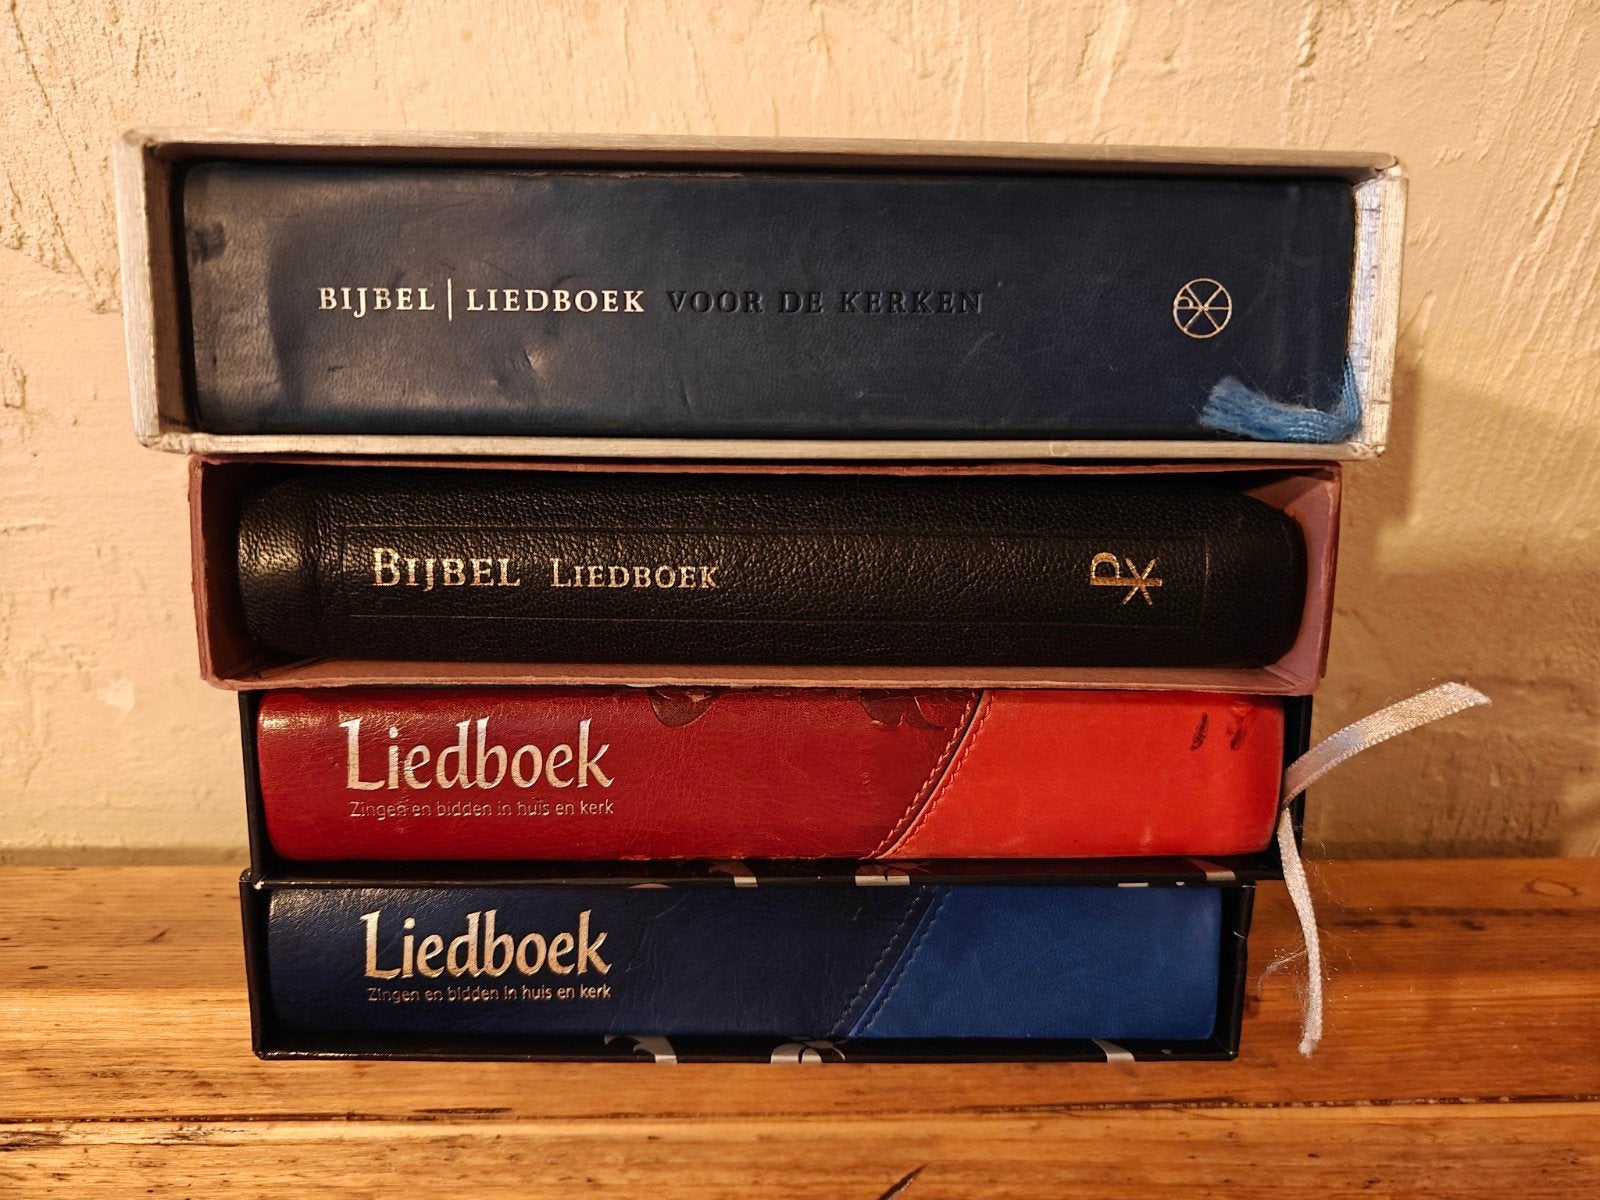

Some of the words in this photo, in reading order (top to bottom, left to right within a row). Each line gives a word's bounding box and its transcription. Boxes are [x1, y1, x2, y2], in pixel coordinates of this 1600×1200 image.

[318, 286, 435, 318] BIJBEL
[466, 288, 645, 313] LIEDBOEK
[666, 290, 764, 314] VOOR
[778, 290, 824, 314] DE
[839, 290, 983, 315] KERKEN
[373, 547, 521, 592] BIJBEL
[550, 557, 719, 588] LIEDBOEK
[339, 716, 615, 791] Liedboek
[350, 801, 408, 820] Zingen
[413, 803, 431, 815] en
[437, 801, 492, 815] bidden
[498, 801, 512, 815] in
[517, 801, 550, 815] huis
[556, 803, 575, 815] en
[580, 800, 614, 814] kerk
[360, 909, 612, 980] Liedboek
[367, 987, 419, 1004] Zingen
[424, 990, 443, 1001] en
[448, 986, 498, 1001] bidden
[504, 985, 517, 999] in
[522, 985, 551, 999] huis
[557, 987, 575, 999] en
[580, 984, 612, 999] kerk
